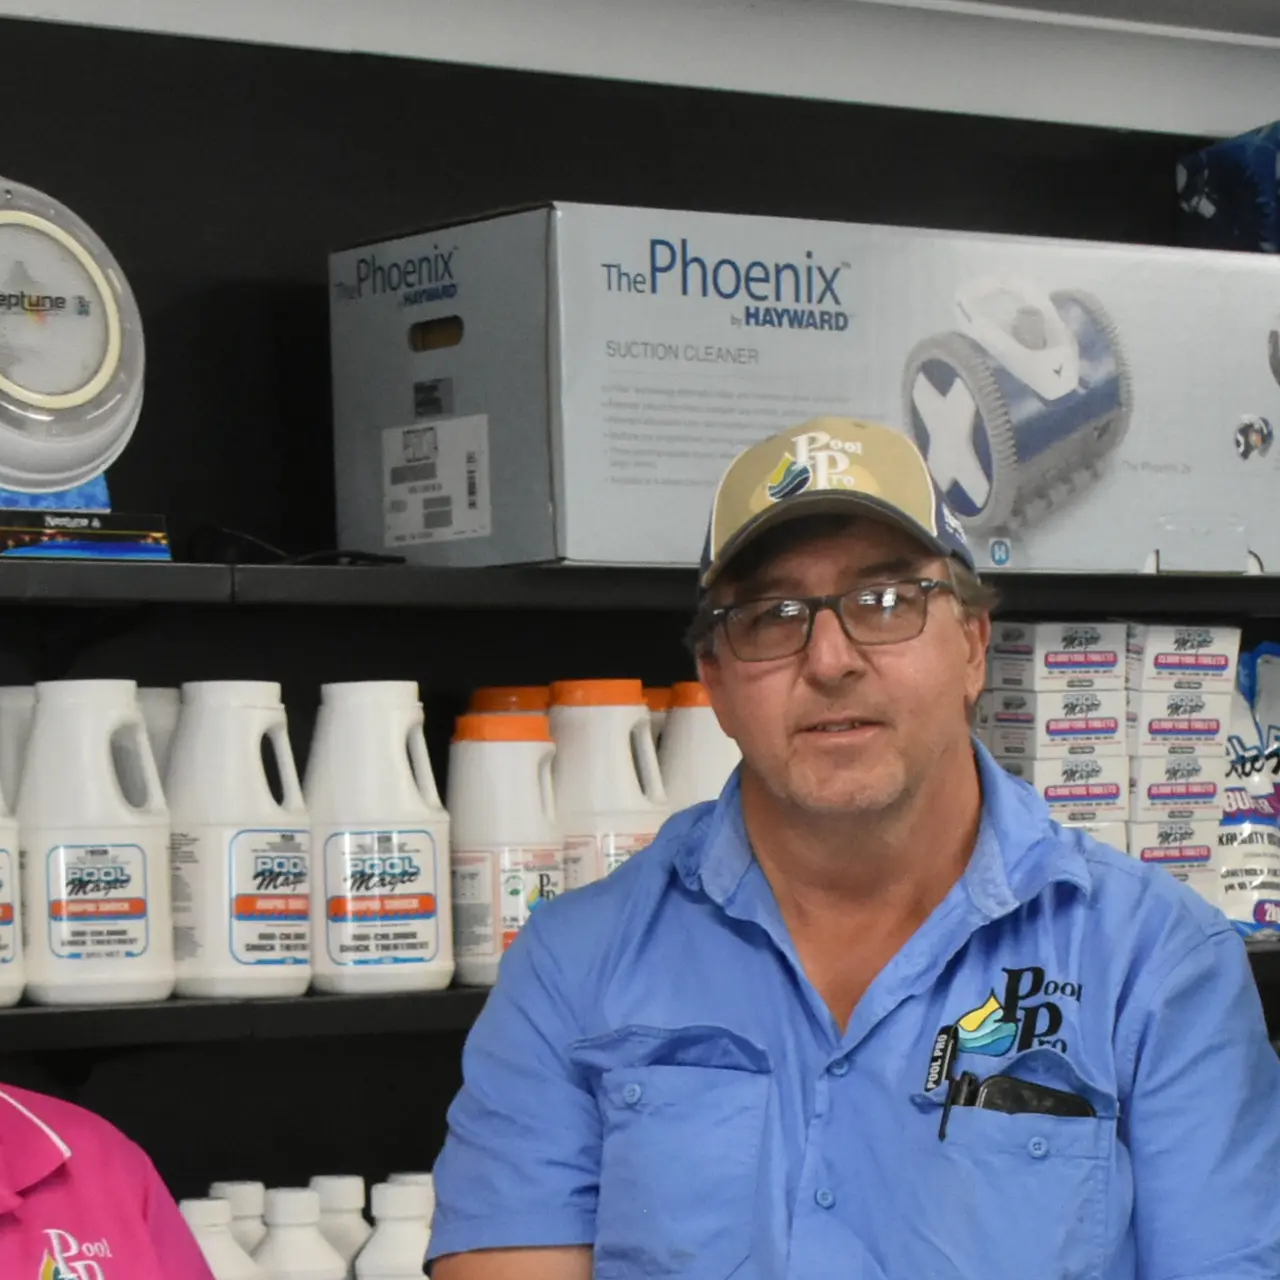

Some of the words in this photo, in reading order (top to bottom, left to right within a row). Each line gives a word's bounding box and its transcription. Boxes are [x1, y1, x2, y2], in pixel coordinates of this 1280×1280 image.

[356, 244, 455, 297] Phoenix
[601, 264, 647, 294] The
[650, 238, 842, 306] Phoenix
[744, 306, 849, 332] HAYWARD
[606, 339, 680, 361] SUCTION
[683, 344, 760, 365] CLEANER
[791, 431, 863, 469] Pool
[811, 450, 855, 490] Pro
[66, 866, 131, 884] POOL
[348, 856, 421, 877] POOL
[994, 966, 1083, 1023] Pool
[933, 1033, 948, 1057] PRO
[1016, 1001, 1067, 1054] Pro
[926, 1057, 943, 1090] POOL
[41, 1228, 113, 1279] Pool
